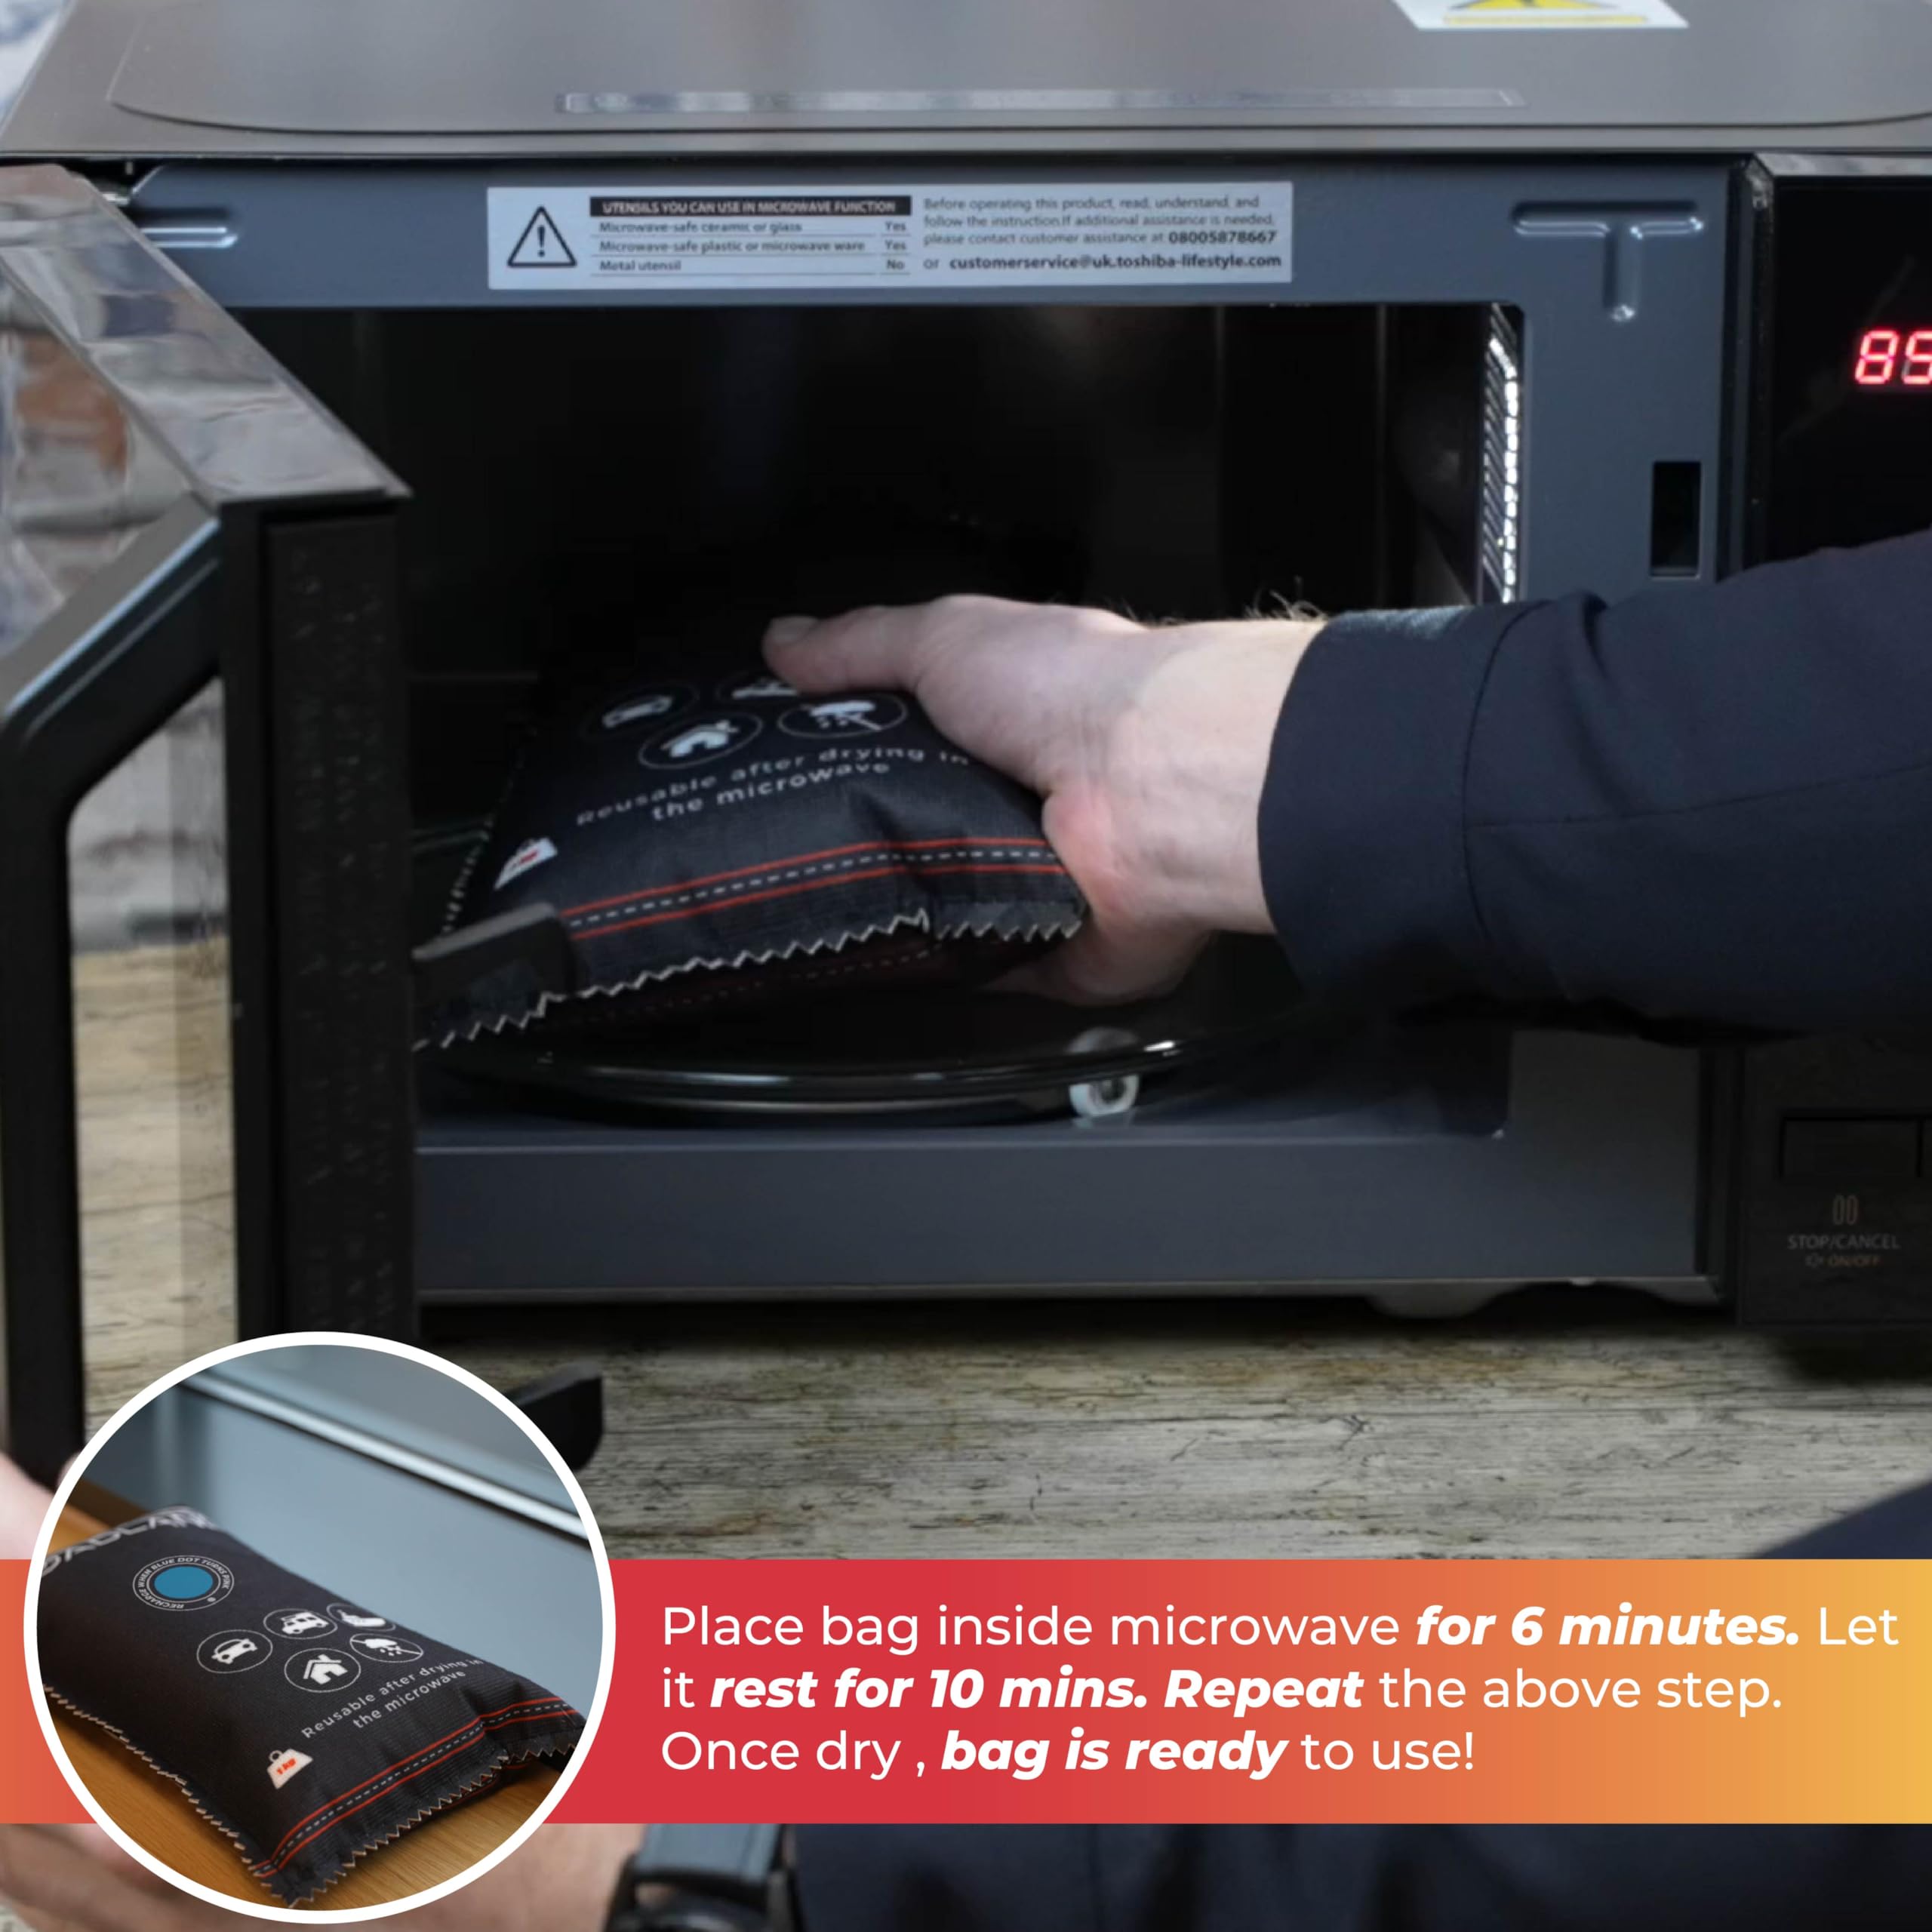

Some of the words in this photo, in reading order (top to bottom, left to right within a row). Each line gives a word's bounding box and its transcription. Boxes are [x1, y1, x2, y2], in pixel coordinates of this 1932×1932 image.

[602, 201, 659, 214] UTENSILS
[663, 201, 688, 214] YOU
[689, 201, 715, 214] CAN
[718, 201, 740, 214] USE
[743, 201, 755, 213] IN
[758, 201, 831, 213] MICROWAVE
[835, 201, 896, 213] FUNCTION
[923, 198, 965, 210] Before
[969, 198, 1032, 212] operating
[1036, 198, 1057, 209] this
[1235, 195, 1260, 208] and
[600, 220, 697, 232] Microwave-safe
[701, 222, 749, 232] ceramic
[769, 222, 803, 235] glass
[885, 221, 906, 231] Yes
[924, 215, 962, 226] follow
[967, 215, 987, 226] the
[1076, 214, 1139, 226] additional
[1143, 215, 1205, 225] assistance
[1210, 214, 1220, 225] is
[600, 240, 697, 251] Microwave-safe
[701, 241, 743, 254] plastic
[746, 242, 759, 251] or
[761, 241, 830, 251] microwave
[834, 242, 865, 251] ware
[885, 240, 907, 250] Yes
[923, 233, 964, 247] please
[968, 234, 1015, 244] contact
[1020, 234, 1078, 244] customer
[1083, 233, 1147, 243] assistance
[1152, 233, 1164, 242] at
[1169, 231, 1277, 244] 08005878667
[600, 260, 635, 270] Metal
[638, 260, 681, 270] utensil
[887, 260, 905, 269] No
[924, 257, 939, 269] or
[949, 253, 1281, 269] customerservice@uk.toshiba-lifestyle.com
[575, 775, 716, 826] Reusable
[731, 755, 804, 780] after
[818, 746, 924, 761] drying
[651, 798, 703, 821] the
[715, 761, 890, 806] microwave
[1787, 1233, 1900, 1250] STOP/CANCEL
[151, 1558, 175, 1571] BLUE
[201, 1559, 227, 1574] TURNS
[137, 1569, 152, 1588] WHEN
[222, 1574, 231, 1589] PINK
[139, 1589, 184, 1608] RECHARGE
[302, 1694, 376, 1739] Reusable
[379, 1673, 415, 1696] after
[419, 1659, 468, 1677] drying
[468, 1658, 483, 1666] in
[352, 1709, 382, 1729] the
[384, 1669, 466, 1712] microwave
